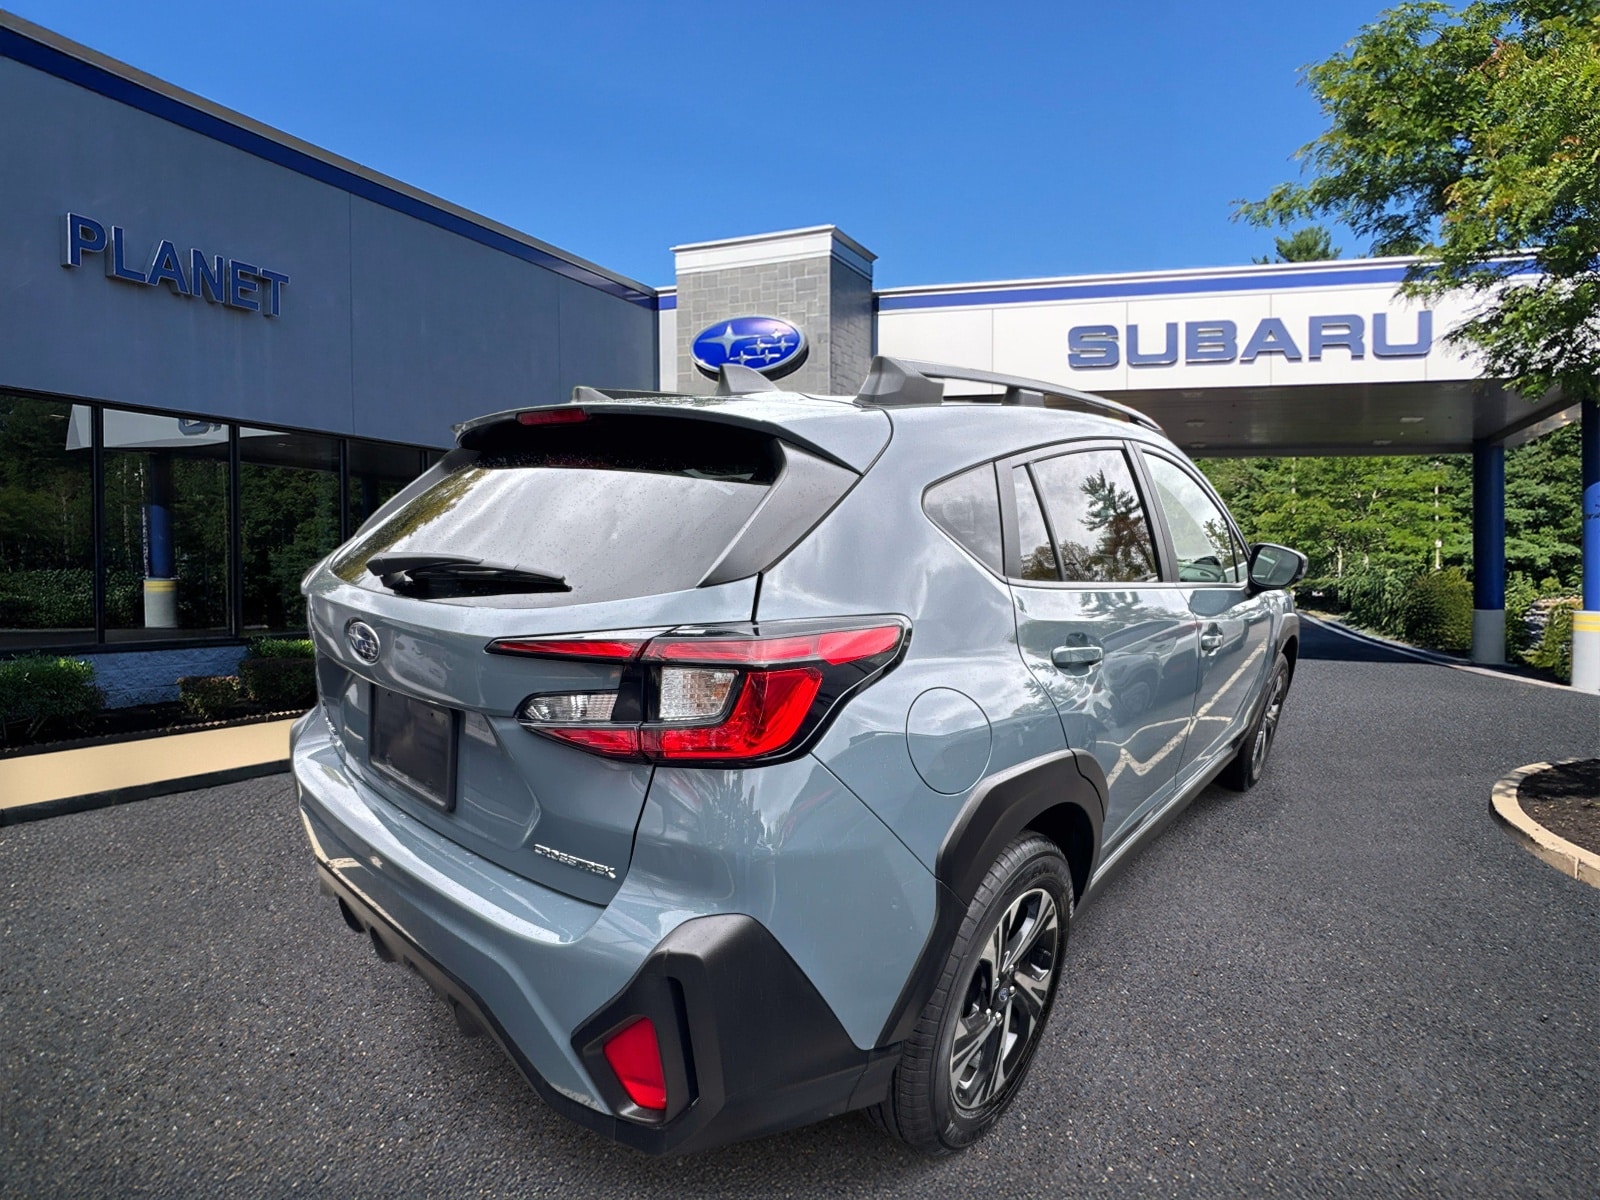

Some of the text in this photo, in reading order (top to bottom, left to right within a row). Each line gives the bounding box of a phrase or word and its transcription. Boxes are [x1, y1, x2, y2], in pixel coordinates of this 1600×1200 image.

[62, 211, 290, 317] PLANET
[1067, 309, 1433, 369] SUBARU
[533, 843, 616, 879] CROSSTREK
